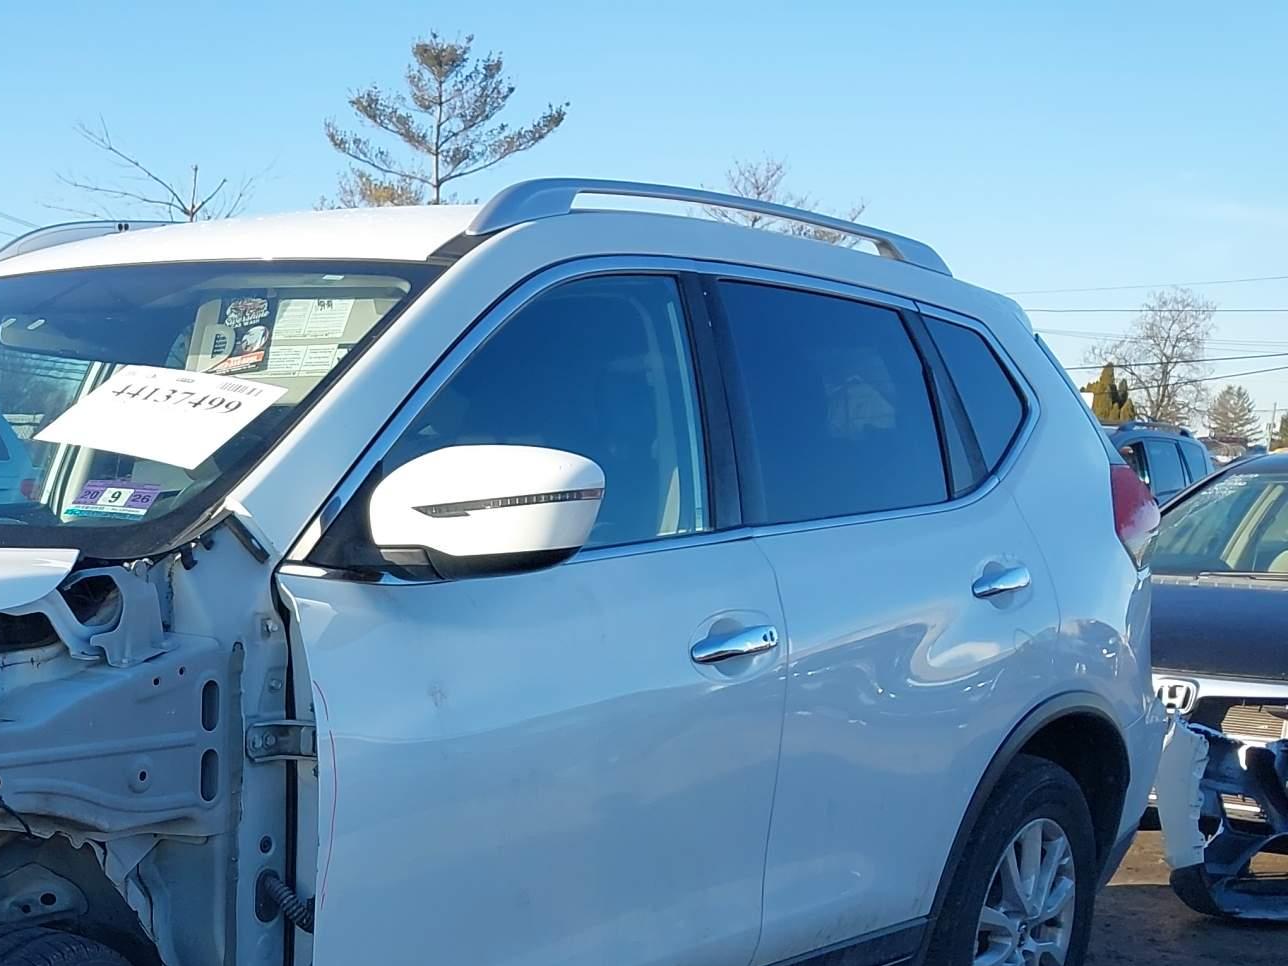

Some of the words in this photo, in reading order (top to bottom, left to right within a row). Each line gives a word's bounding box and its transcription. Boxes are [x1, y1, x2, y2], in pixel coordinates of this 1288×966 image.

[112, 383, 243, 413] 44137499
[80, 490, 100, 499] 20
[108, 490, 122, 503] 9
[131, 494, 152, 503] 26
